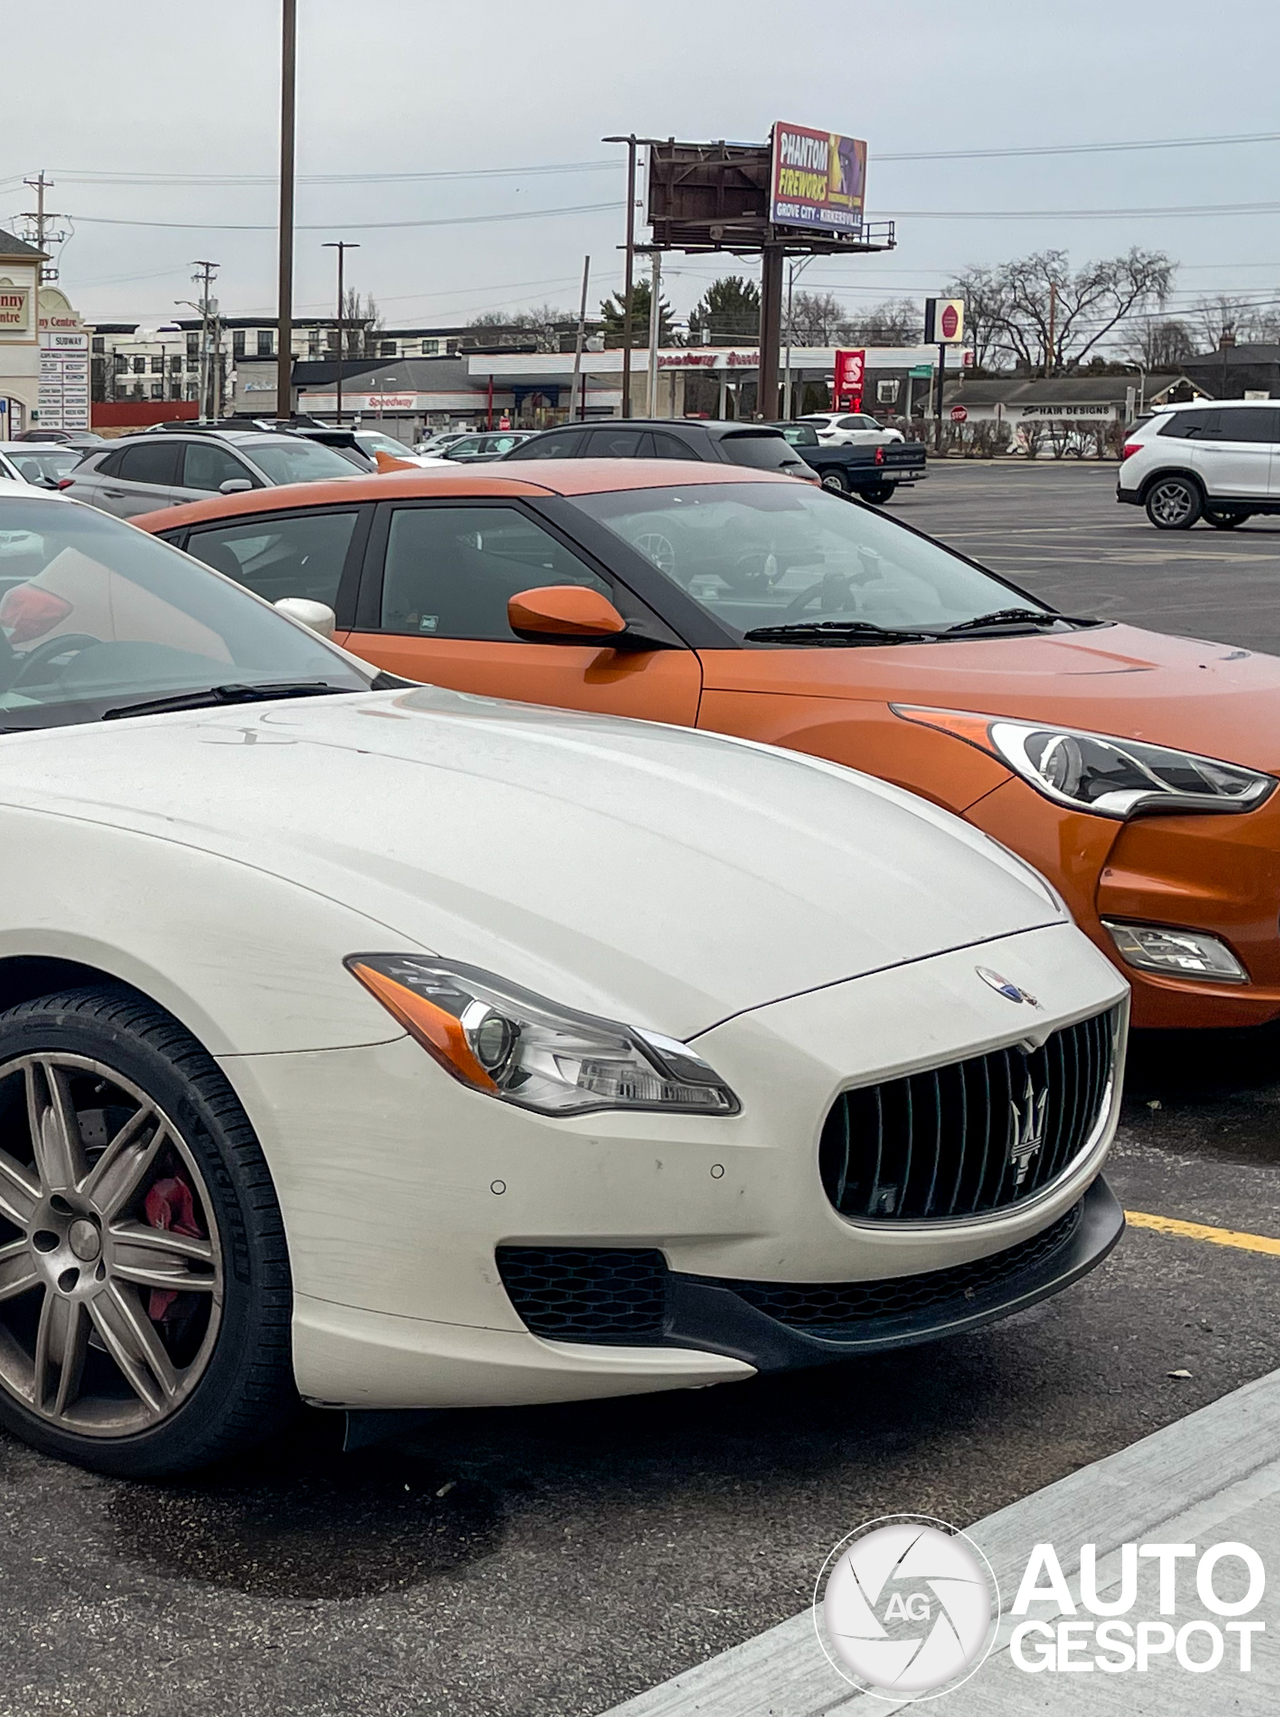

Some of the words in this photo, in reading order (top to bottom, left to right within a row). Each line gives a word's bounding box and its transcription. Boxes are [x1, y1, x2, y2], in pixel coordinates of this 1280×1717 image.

[780, 132, 828, 171] PHANTOM
[778, 167, 827, 202] FIREWORKS
[776, 202, 800, 218] GROVE
[800, 204, 816, 221] CITY
[820, 208, 862, 227] KIRKERSVILLE
[50, 316, 77, 327] Centre
[657, 352, 719, 368] peedway
[369, 397, 414, 408] Speedway
[951, 410, 967, 420] STOP
[1040, 407, 1063, 415] HAIR
[1066, 406, 1109, 415] DESIGNS
